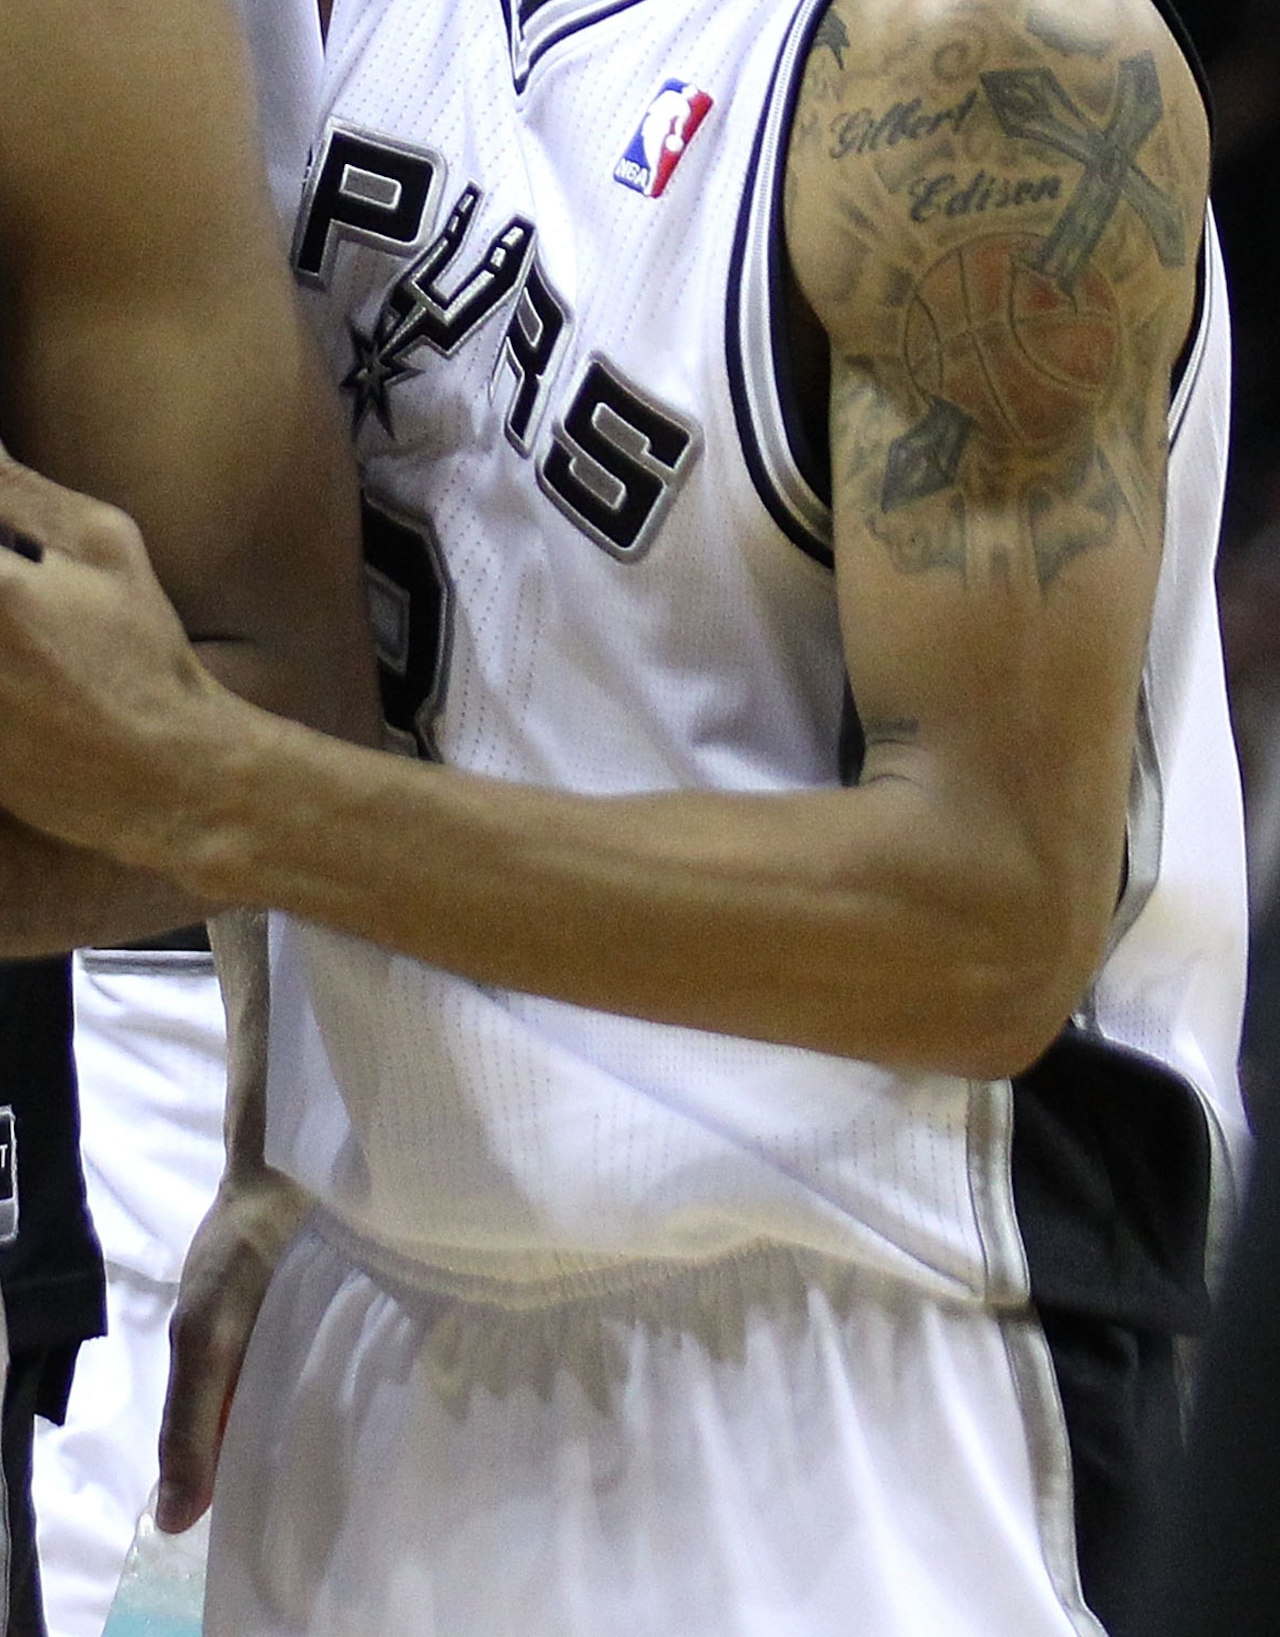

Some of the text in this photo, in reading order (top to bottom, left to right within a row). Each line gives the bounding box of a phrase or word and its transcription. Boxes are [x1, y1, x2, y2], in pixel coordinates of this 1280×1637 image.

[615, 157, 650, 191] NBA
[908, 169, 1063, 223] Edison
[290, 116, 705, 563] PURS
